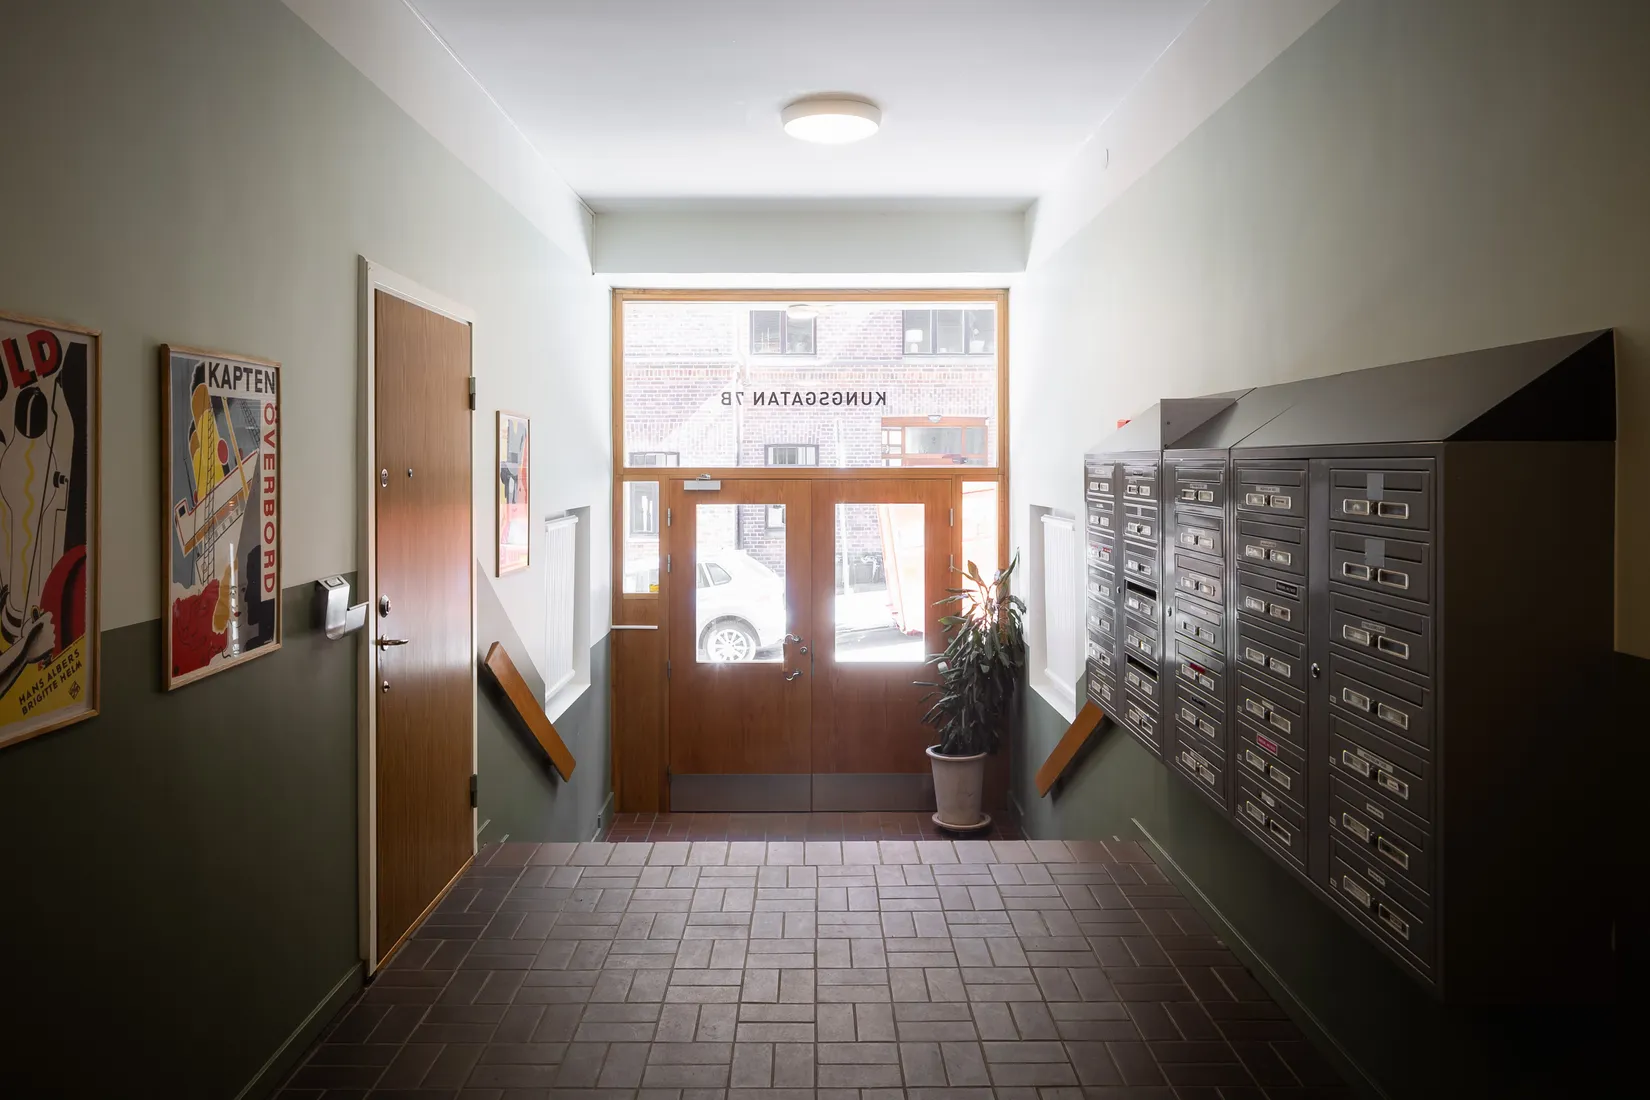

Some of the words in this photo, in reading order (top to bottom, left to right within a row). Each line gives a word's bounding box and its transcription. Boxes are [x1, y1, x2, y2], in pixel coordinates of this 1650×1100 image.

[0, 329, 62, 401] LD
[208, 361, 275, 395] KAPTEN
[18, 677, 45, 705] HANS
[47, 648, 80, 682] ALBERS
[22, 680, 58, 716] BRIGITTE
[60, 660, 83, 683] HELM
